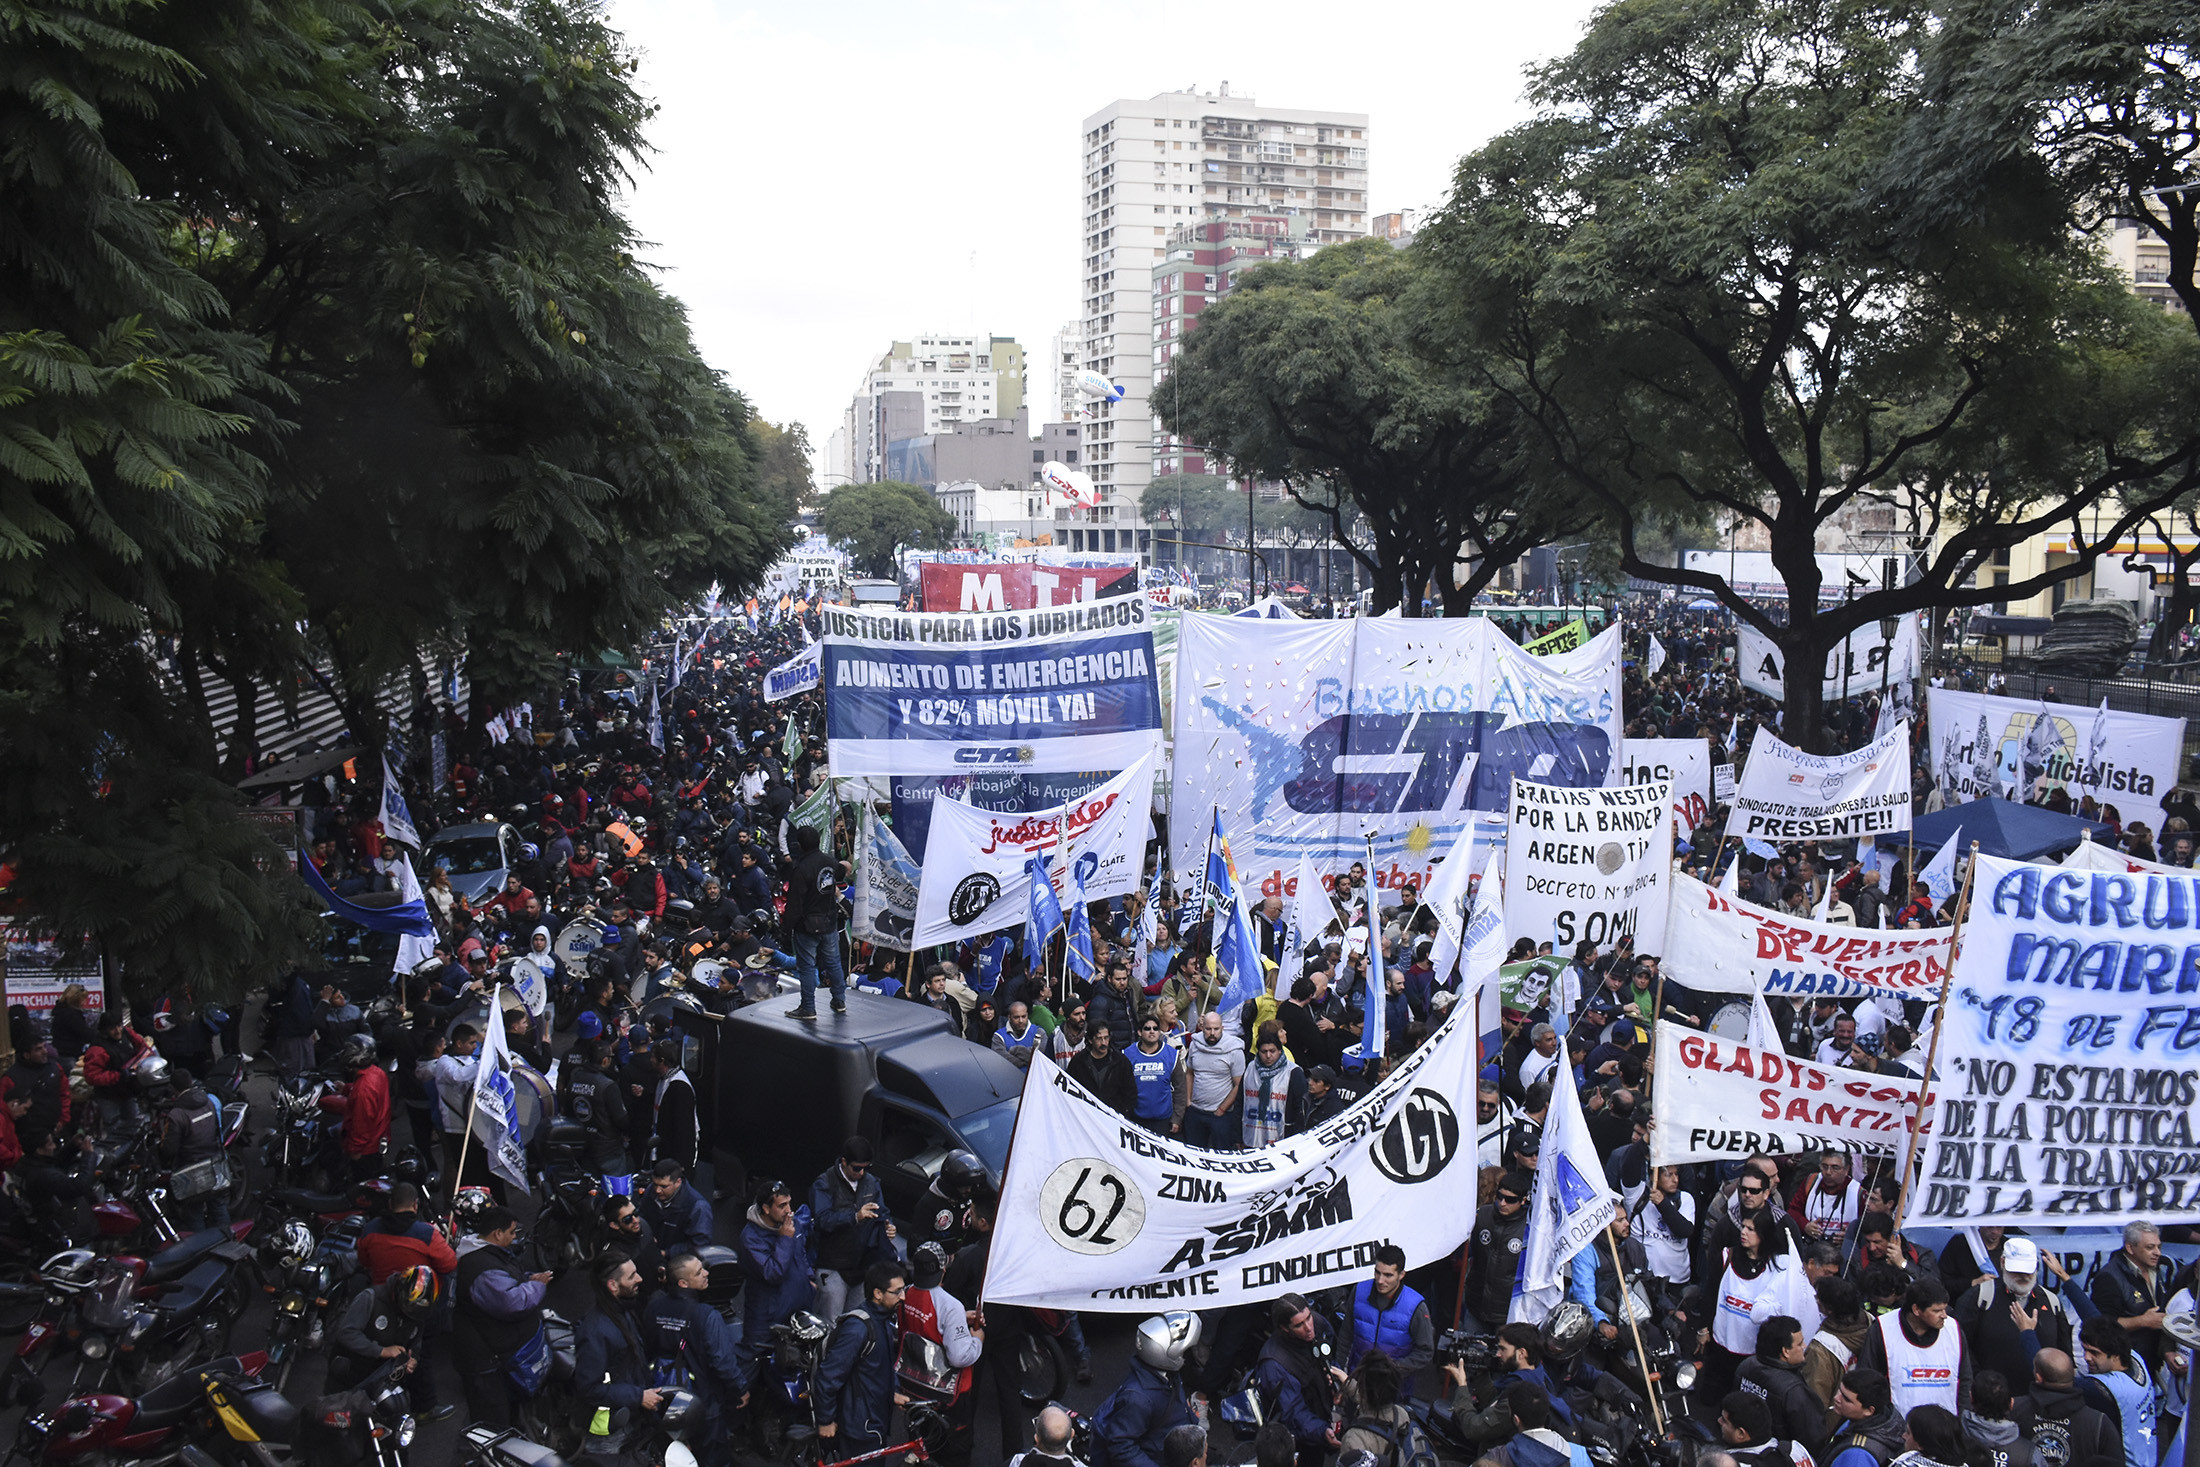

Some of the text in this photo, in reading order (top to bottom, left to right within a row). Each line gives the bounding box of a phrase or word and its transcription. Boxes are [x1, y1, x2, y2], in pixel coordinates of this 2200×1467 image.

[802, 567, 834, 578] PLATA
[823, 598, 1145, 642] JUSTICIA PARA LOS JUBILADOS
[836, 658, 951, 690] AUMENTO
[954, 664, 988, 690] DE
[991, 648, 1149, 689] EMERGENCIA
[898, 691, 1097, 727] Y 82% MÓVIL YA!
[1315, 676, 1613, 726] Buenos Aires
[953, 747, 1021, 763] CTA
[1028, 784, 1040, 797] la
[1737, 797, 1785, 816] SINDICATO
[1785, 805, 1797, 816] DE
[1859, 797, 1868, 810] DE
[1870, 795, 1880, 807] LA
[1883, 792, 1909, 806] SALUD
[1515, 805, 1556, 831] POR
[1565, 811, 1589, 833] LA
[1746, 810, 1893, 837] PRESENTE!!
[1100, 854, 1126, 869] CLATE
[1528, 840, 1595, 865] ARGEN
[1993, 866, 2200, 930] AGRU
[1431, 901, 1460, 942] ARGENTINA
[1756, 927, 1804, 963] DE
[88, 994, 101, 1005] 29
[2066, 1014, 2122, 1049] DE
[1679, 1036, 1831, 1091] GLADYS
[2026, 1063, 2200, 1107] ESTAMOS
[1939, 1100, 1977, 1138] DE
[1983, 1101, 2033, 1141] LA
[1120, 1127, 1275, 1175] MENSAJEROS
[1283, 1149, 1299, 1165] Y
[1690, 1128, 1786, 1154] FUERA
[1796, 1132, 1835, 1152] DE
[1931, 1140, 1977, 1182] EN
[1978, 1142, 2027, 1184] LA
[1157, 1172, 1227, 1204] ZONA
[1921, 1183, 1971, 1219] DE
[1973, 1186, 2034, 1217] LA
[1058, 1167, 1128, 1245] 62
[1160, 1176, 1353, 1275] ASIMM
[955, 1325, 965, 1335] 32
[1910, 1368, 1951, 1379] CTA
[2032, 1423, 2071, 1439] PARIENTE
